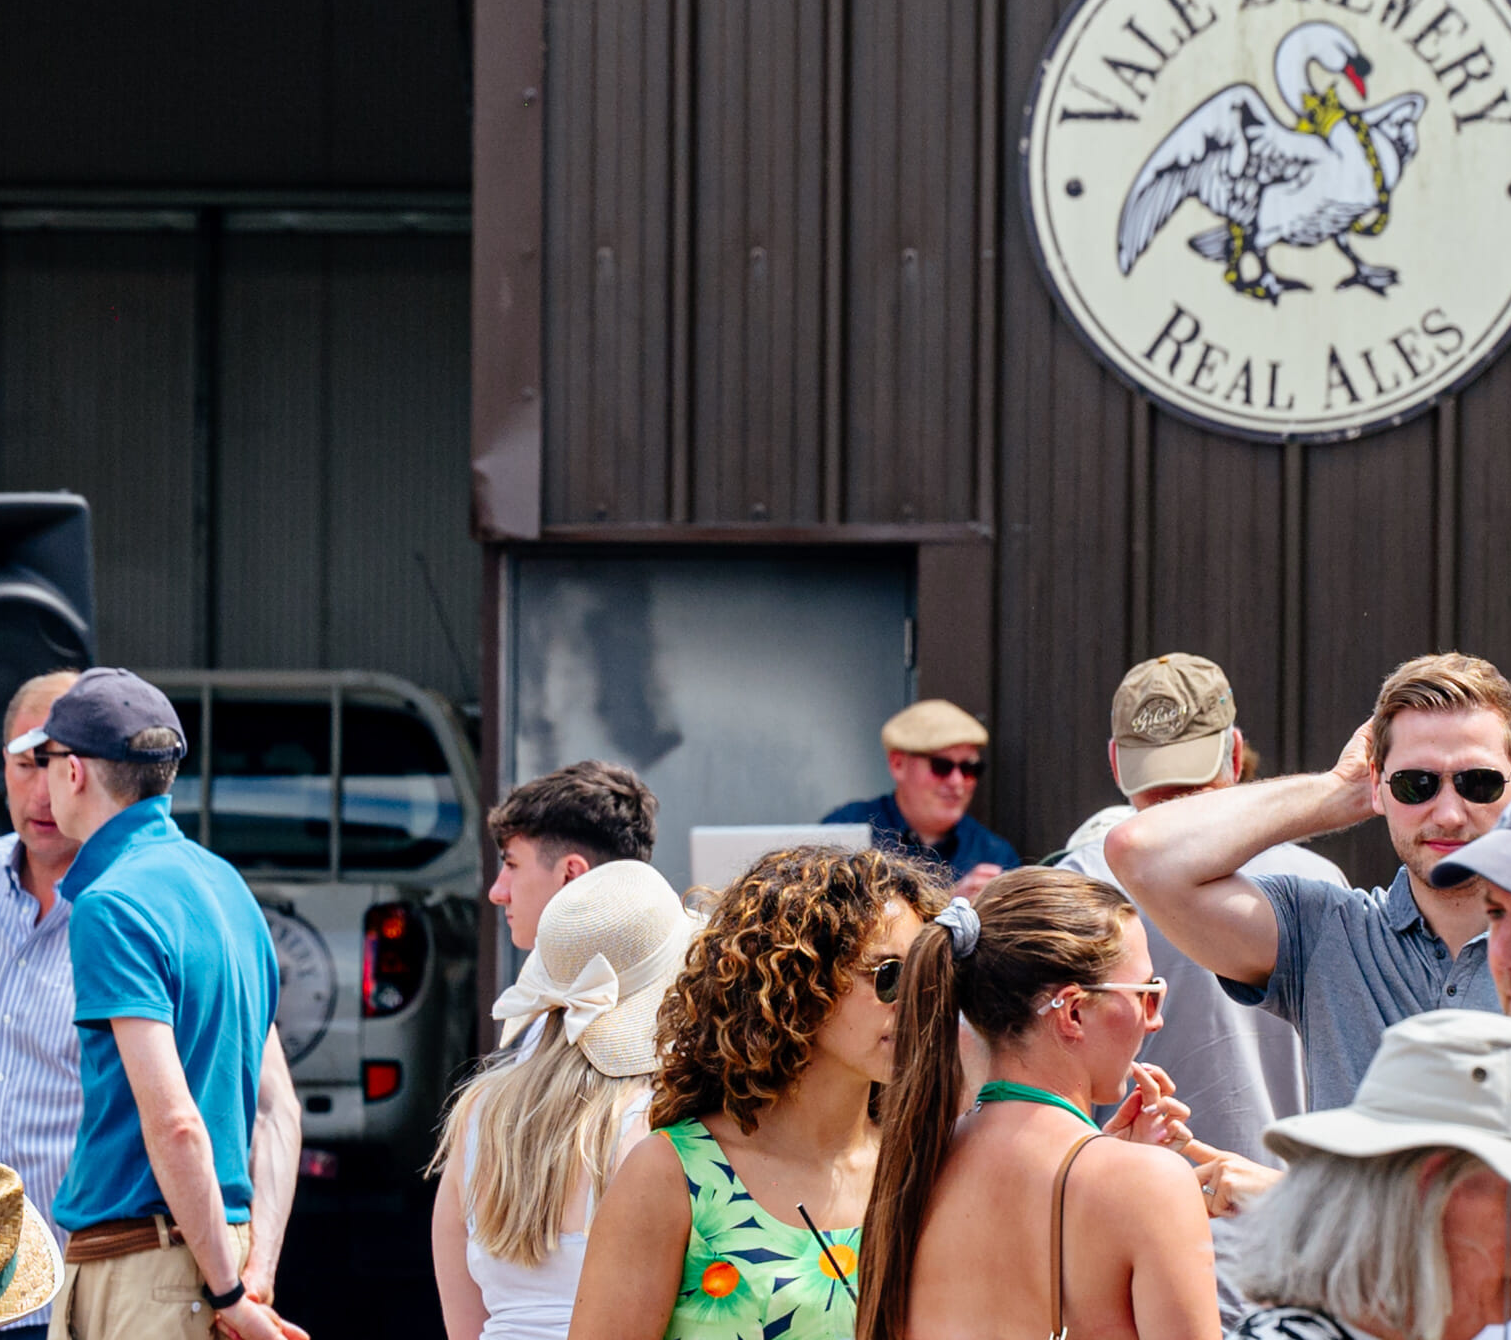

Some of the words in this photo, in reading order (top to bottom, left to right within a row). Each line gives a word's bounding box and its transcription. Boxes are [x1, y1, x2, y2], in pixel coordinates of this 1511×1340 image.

[1142, 301, 1297, 412] REAL
[1322, 307, 1467, 411] ALES
[1131, 706, 1188, 734] Gibson
